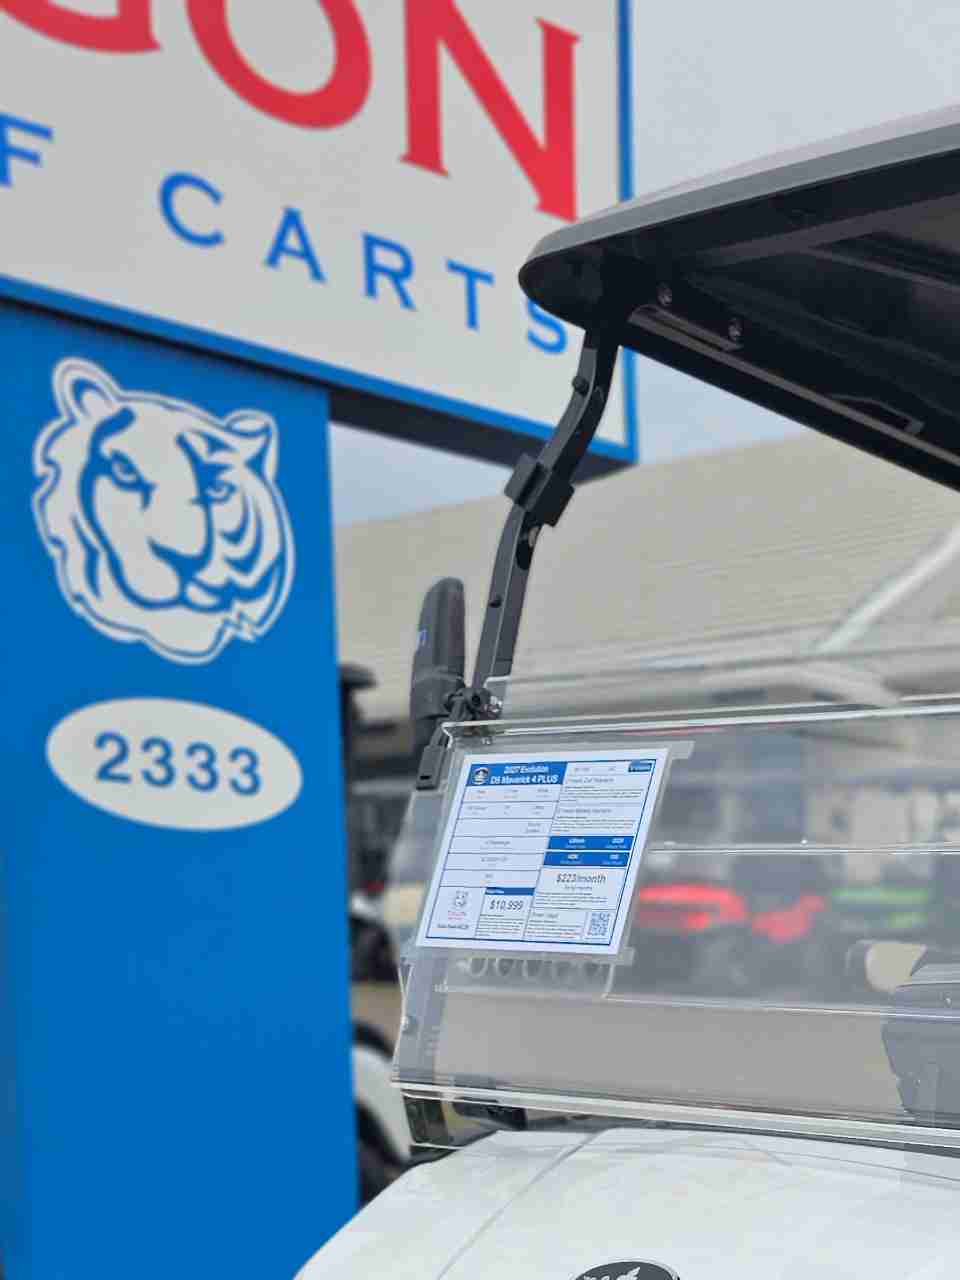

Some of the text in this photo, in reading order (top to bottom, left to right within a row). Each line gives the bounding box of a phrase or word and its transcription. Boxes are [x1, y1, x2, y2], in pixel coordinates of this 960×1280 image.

[0, 0, 580, 222] ON
[94, 730, 262, 797] 2333
[537, 774, 560, 784] PLUS
